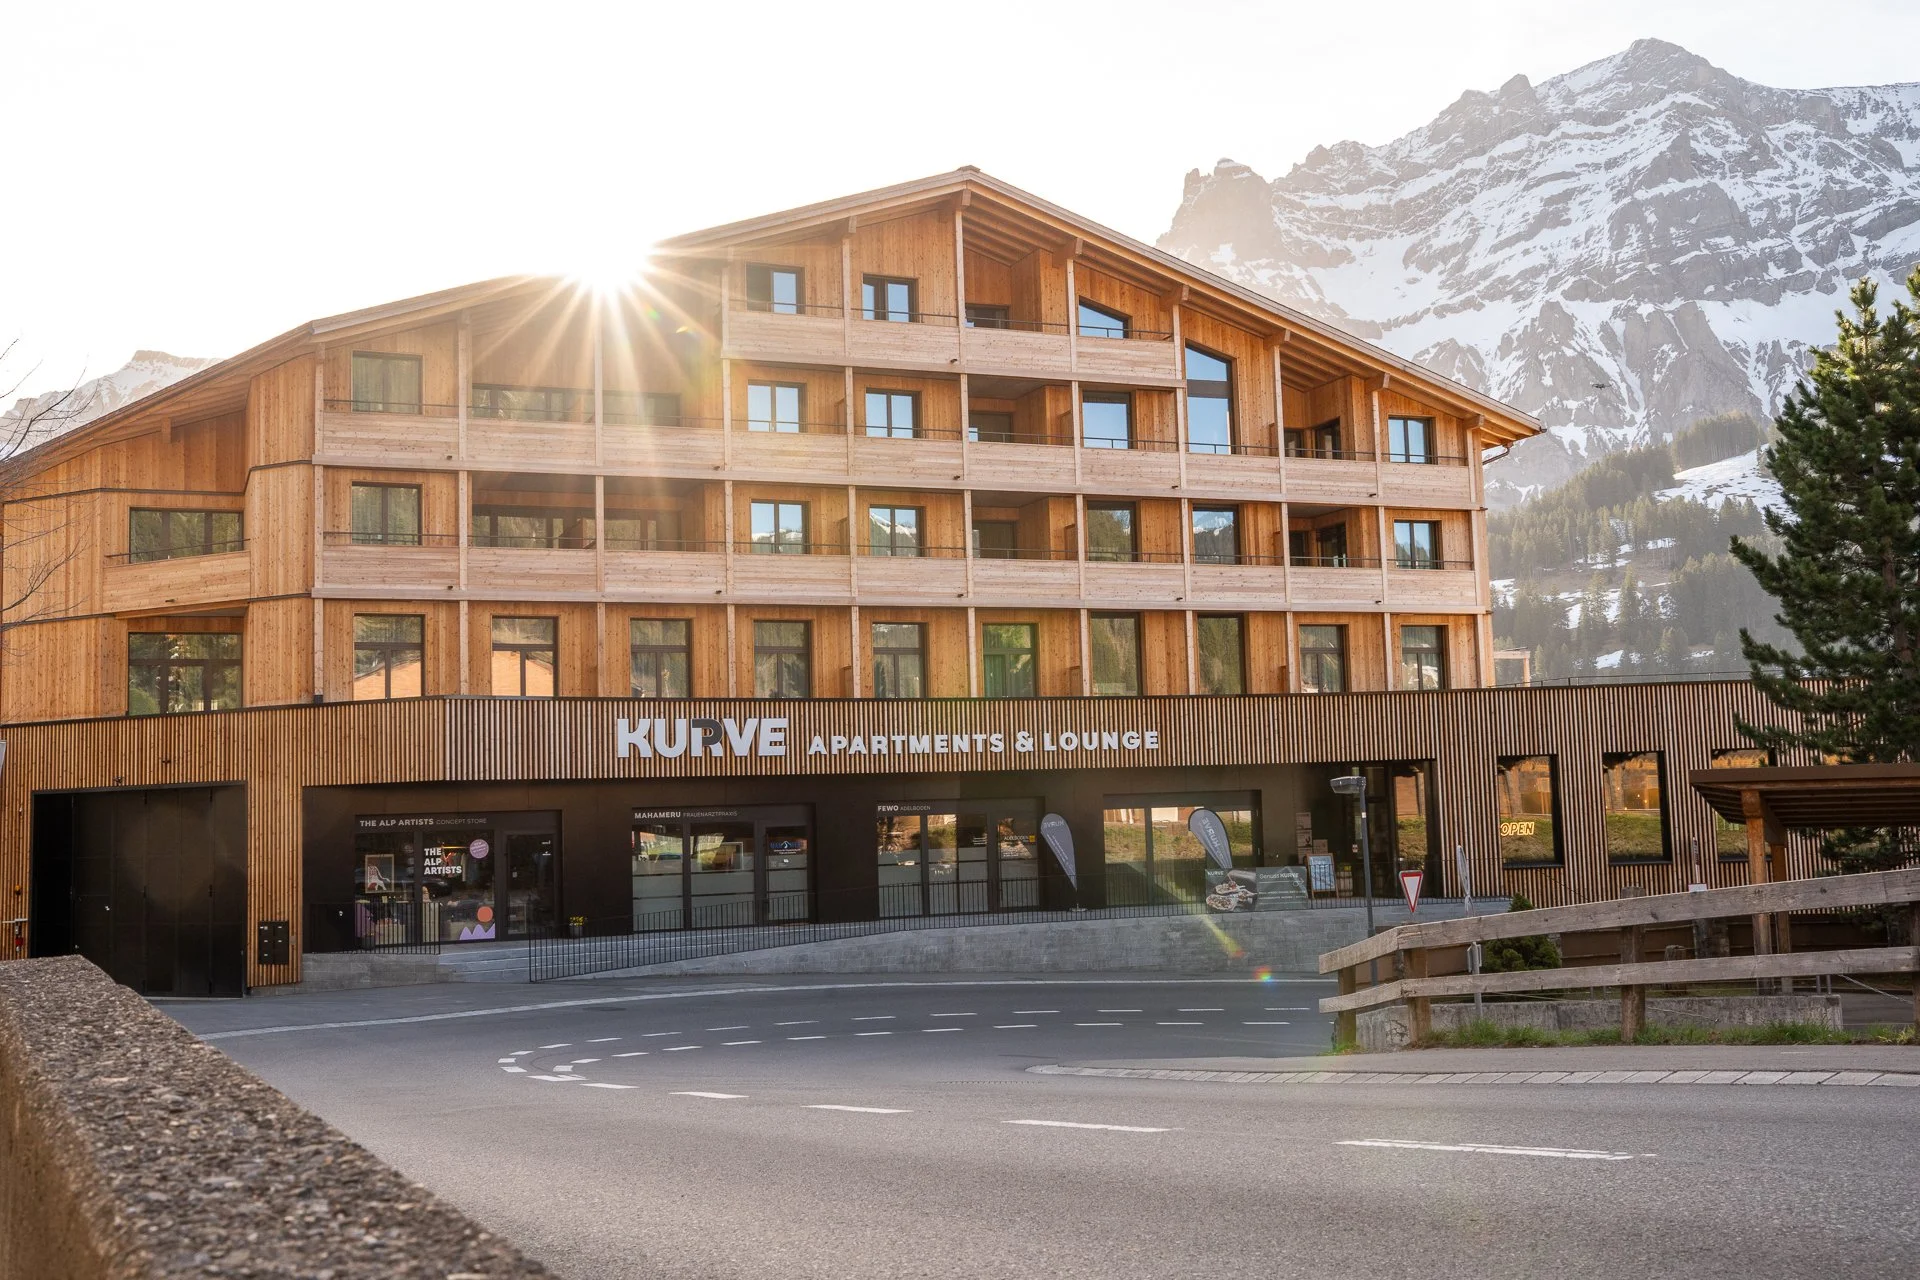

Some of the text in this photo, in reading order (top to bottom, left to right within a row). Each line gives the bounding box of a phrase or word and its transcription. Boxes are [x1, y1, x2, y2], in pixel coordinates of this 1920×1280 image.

[616, 718, 789, 758] KURVE
[807, 730, 1160, 756] APARTMENTS & LOUNGE
[634, 811, 681, 819] MAHAMERU
[379, 819, 397, 827] ALP
[398, 818, 434, 826] ARTISTS
[436, 818, 466, 826] CONCEPT
[1500, 821, 1535, 836] OPEN
[424, 848, 442, 857] THE
[424, 858, 442, 866] ALP
[424, 866, 463, 876] ARTISTS
